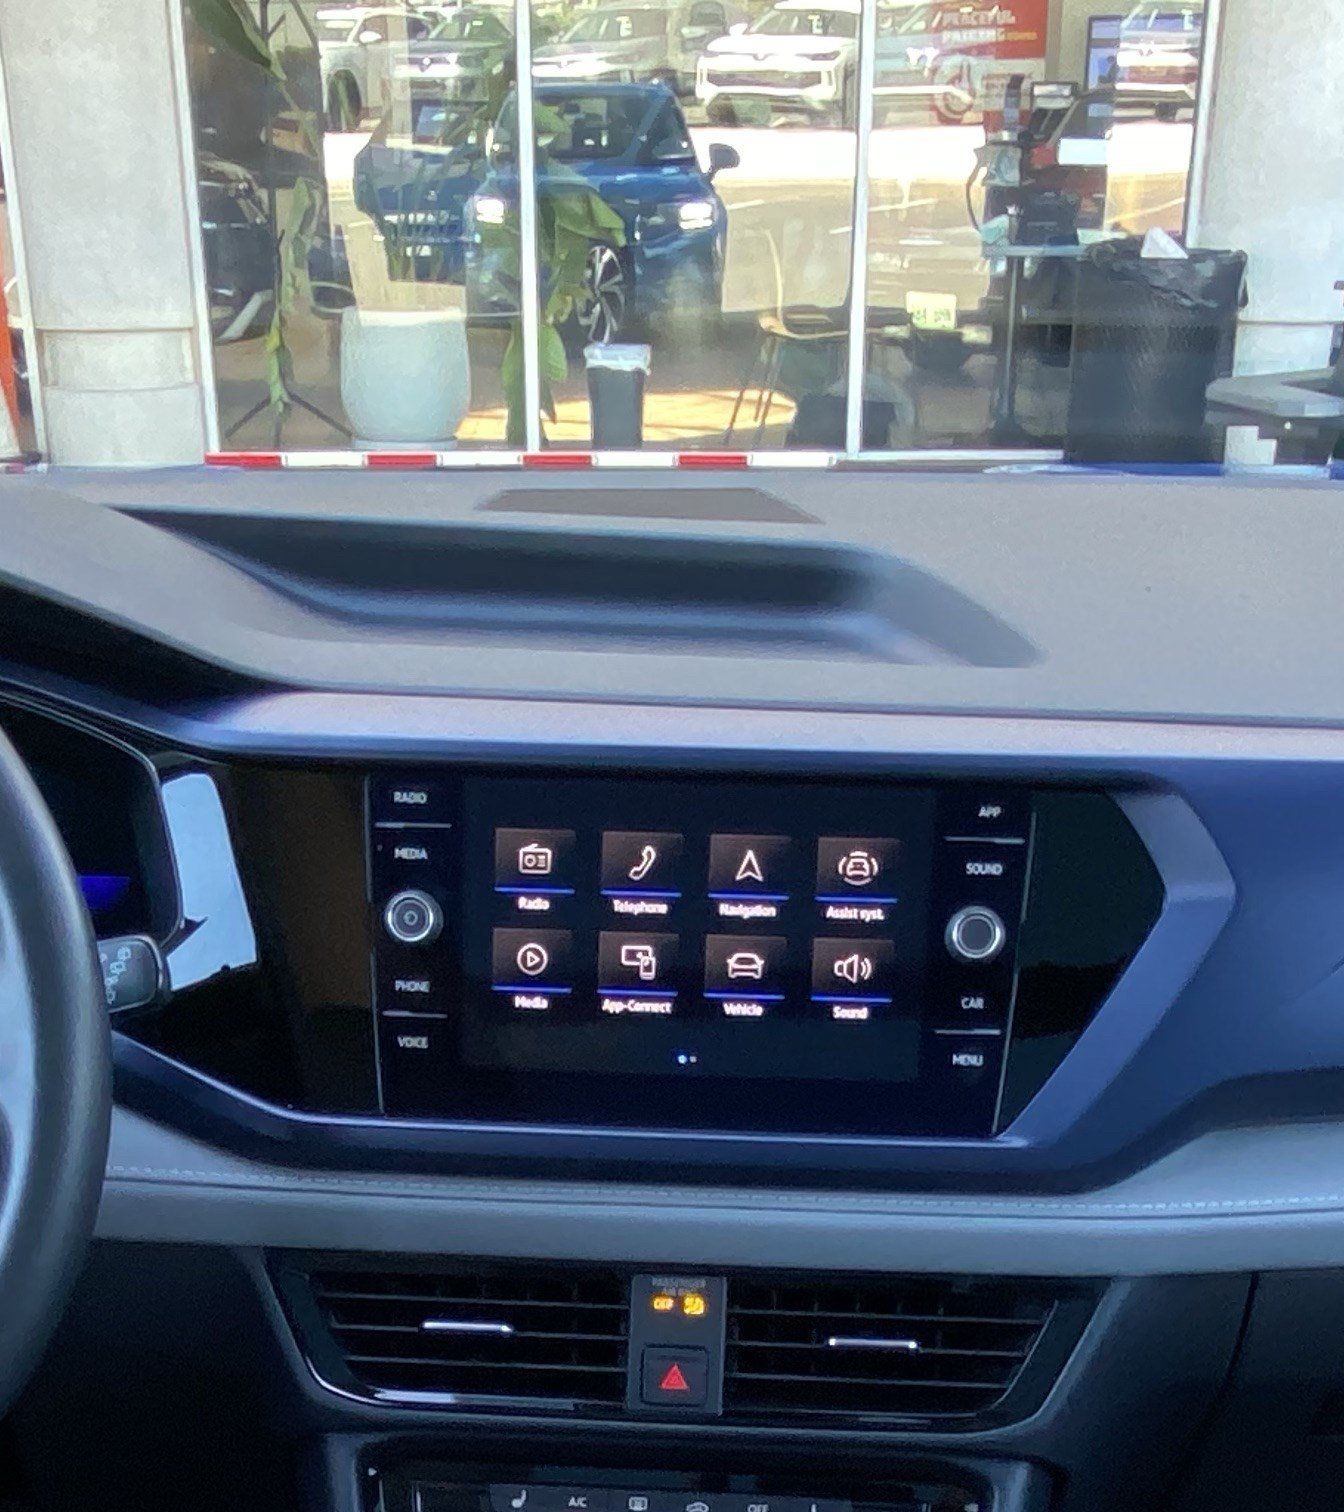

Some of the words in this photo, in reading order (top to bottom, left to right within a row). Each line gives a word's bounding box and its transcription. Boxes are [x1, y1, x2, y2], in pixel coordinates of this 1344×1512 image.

[393, 791, 428, 805] RADIO
[978, 806, 1002, 818] APP
[394, 847, 429, 860] MEDIA
[965, 863, 1003, 876] SOUND
[517, 896, 550, 910] Radio
[613, 899, 668, 915] Telephone
[718, 903, 777, 919] Navigation
[826, 905, 857, 920] Assist
[859, 908, 885, 922] syst.
[395, 980, 431, 993] PHONE
[514, 995, 549, 1009] Media
[602, 998, 673, 1014] App-Connect
[722, 1002, 764, 1016] Vehicle
[961, 997, 984, 1010] CAR
[832, 1005, 868, 1019] Sound
[397, 1035, 429, 1049] VOICE
[952, 1053, 984, 1067] MENU
[568, 1496, 587, 1509] A/C
